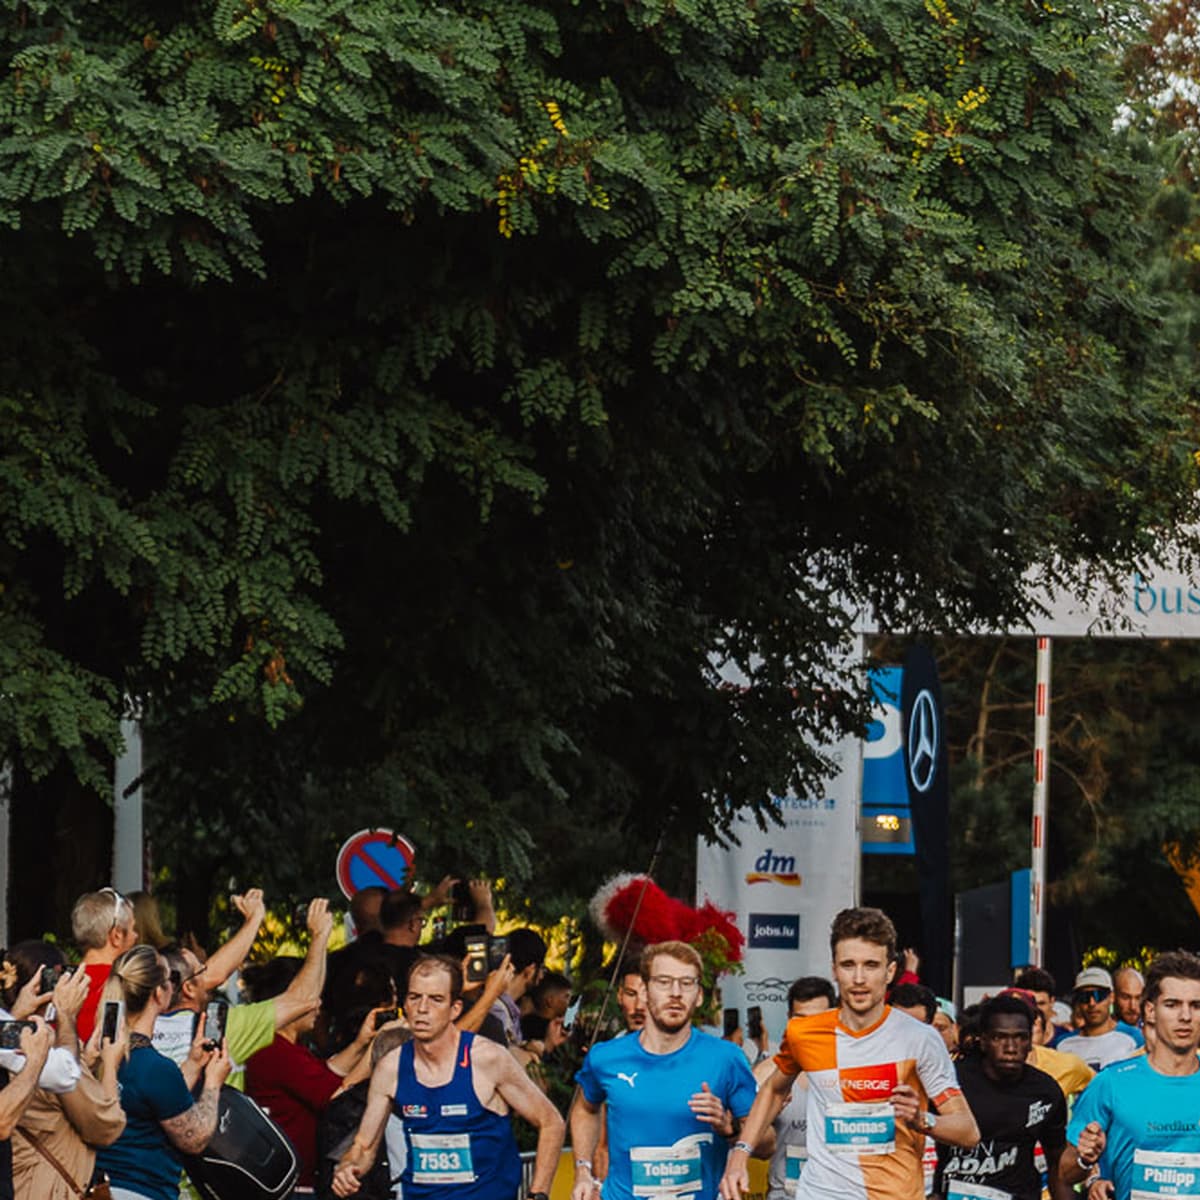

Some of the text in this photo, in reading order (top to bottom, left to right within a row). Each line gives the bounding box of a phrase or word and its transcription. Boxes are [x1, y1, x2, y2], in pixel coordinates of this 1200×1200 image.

[754, 849, 796, 873] dm
[754, 923, 795, 939] jobs.lu
[832, 1119, 887, 1134] Thomas
[1146, 1119, 1197, 1132] Nordlux
[419, 1152, 460, 1171] 7583
[943, 1146, 1018, 1176] ADAM
[643, 1163, 690, 1177] Tobias
[1143, 1167, 1196, 1187] Philipp
